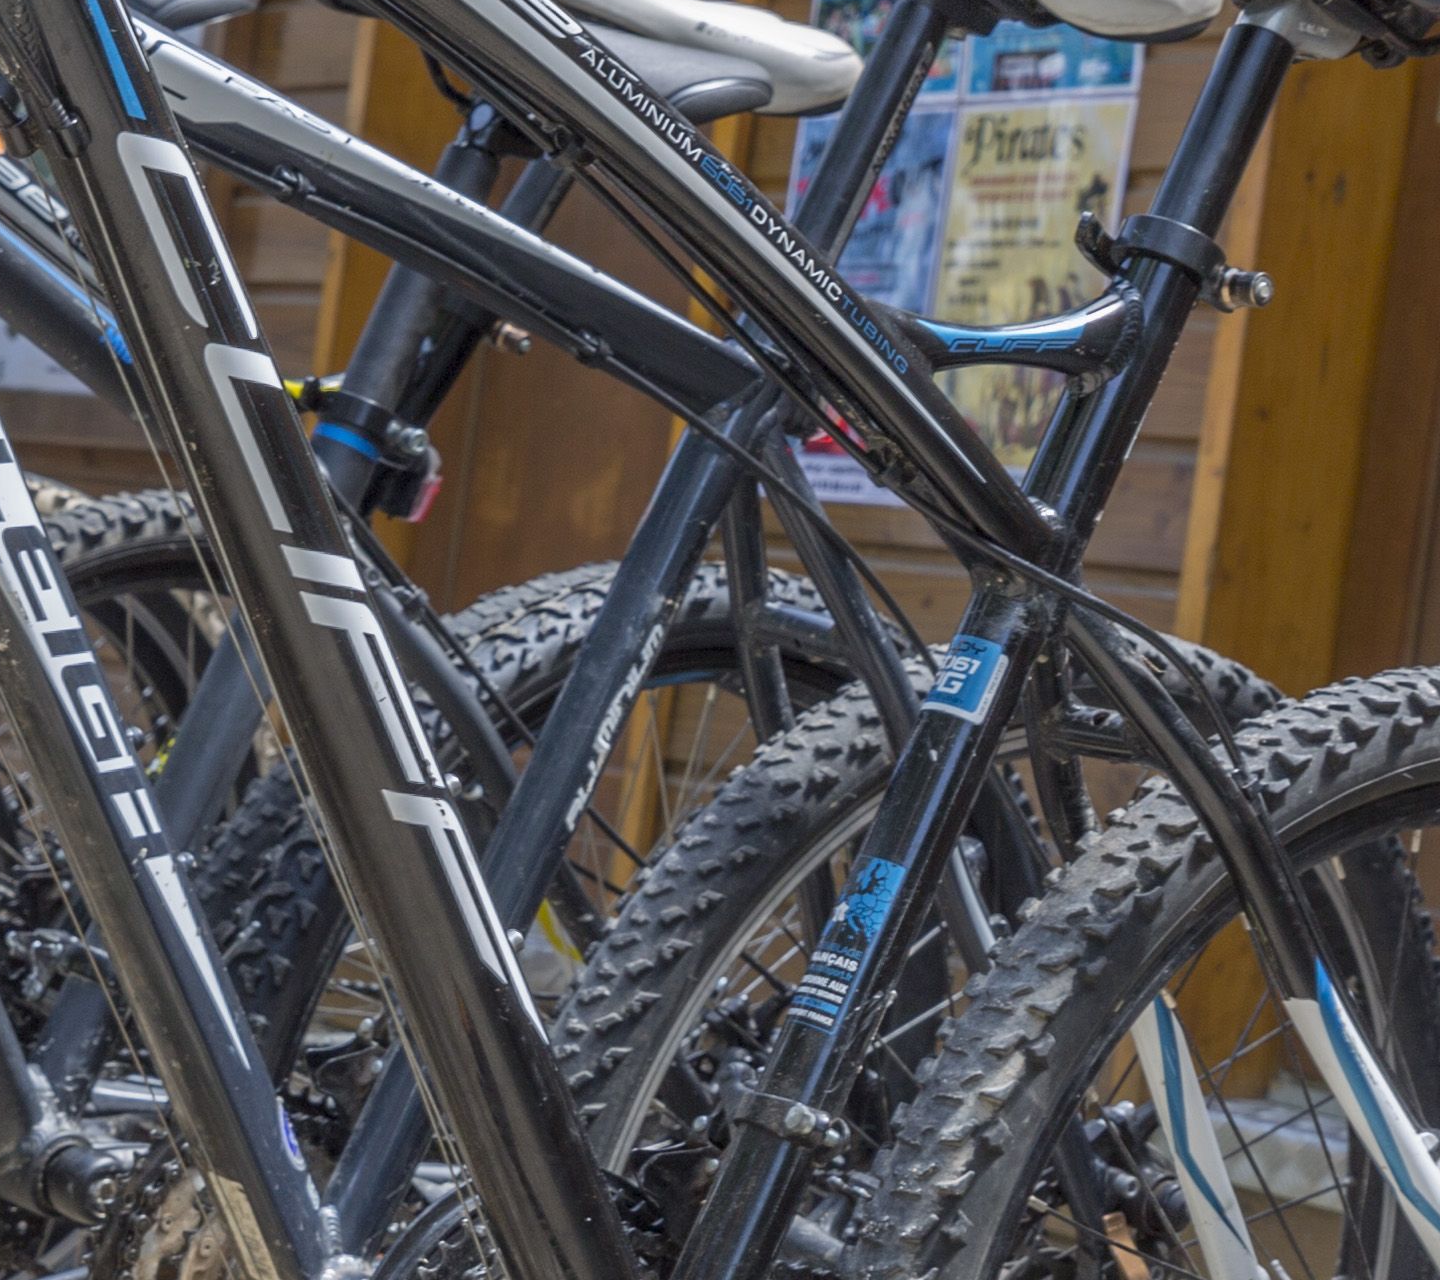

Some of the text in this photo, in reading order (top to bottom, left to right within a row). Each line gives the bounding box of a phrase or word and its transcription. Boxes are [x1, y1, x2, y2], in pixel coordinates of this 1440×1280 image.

[580, 48, 703, 163] ALUMINIUM
[749, 203, 844, 303] DYNAMIC
[839, 295, 910, 376] TUBING
[117, 131, 552, 1044] CLIFF
[941, 655, 982, 677] 061
[810, 950, 860, 974] ANÇAIS
